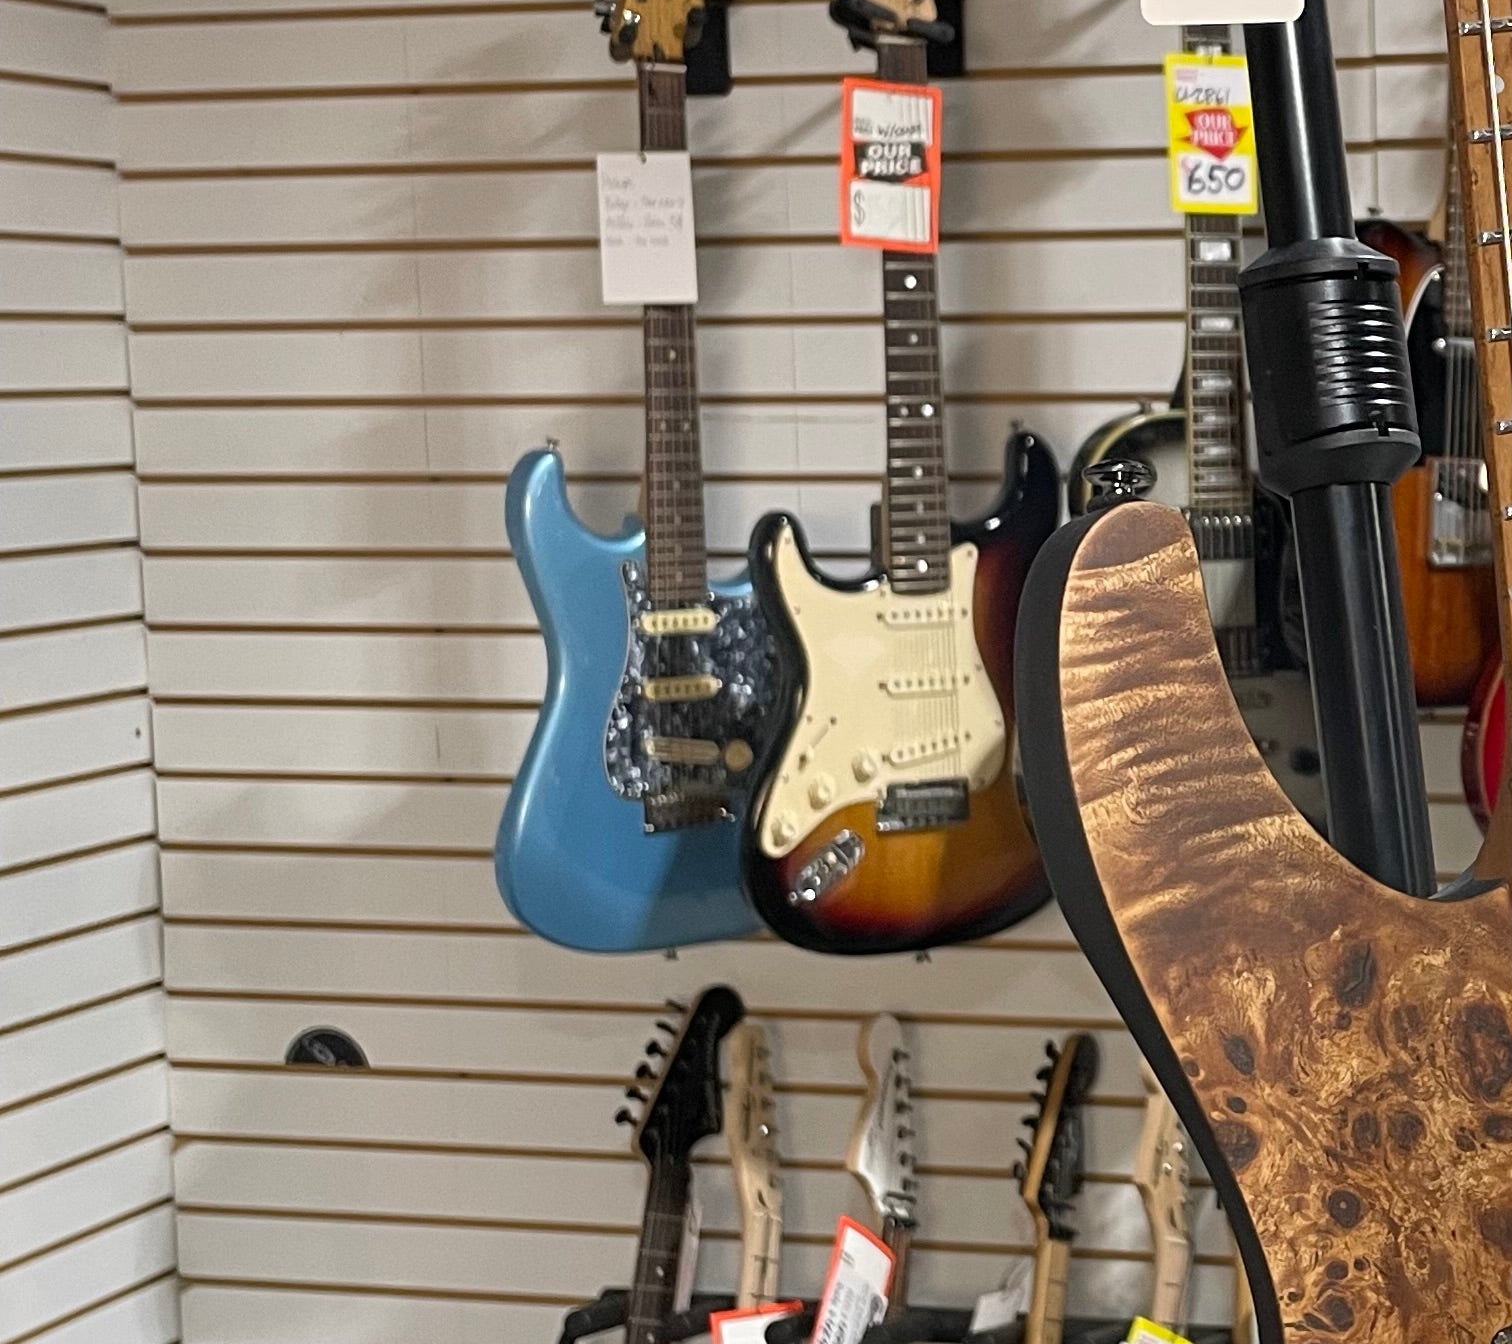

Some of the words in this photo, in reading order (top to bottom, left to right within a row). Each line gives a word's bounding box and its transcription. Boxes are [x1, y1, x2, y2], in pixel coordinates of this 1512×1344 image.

[1196, 113, 1232, 130] OUR
[1192, 130, 1235, 146] PRICE
[868, 142, 912, 159] OUR
[860, 157, 922, 176] PRICE
[1188, 163, 1245, 195] 650
